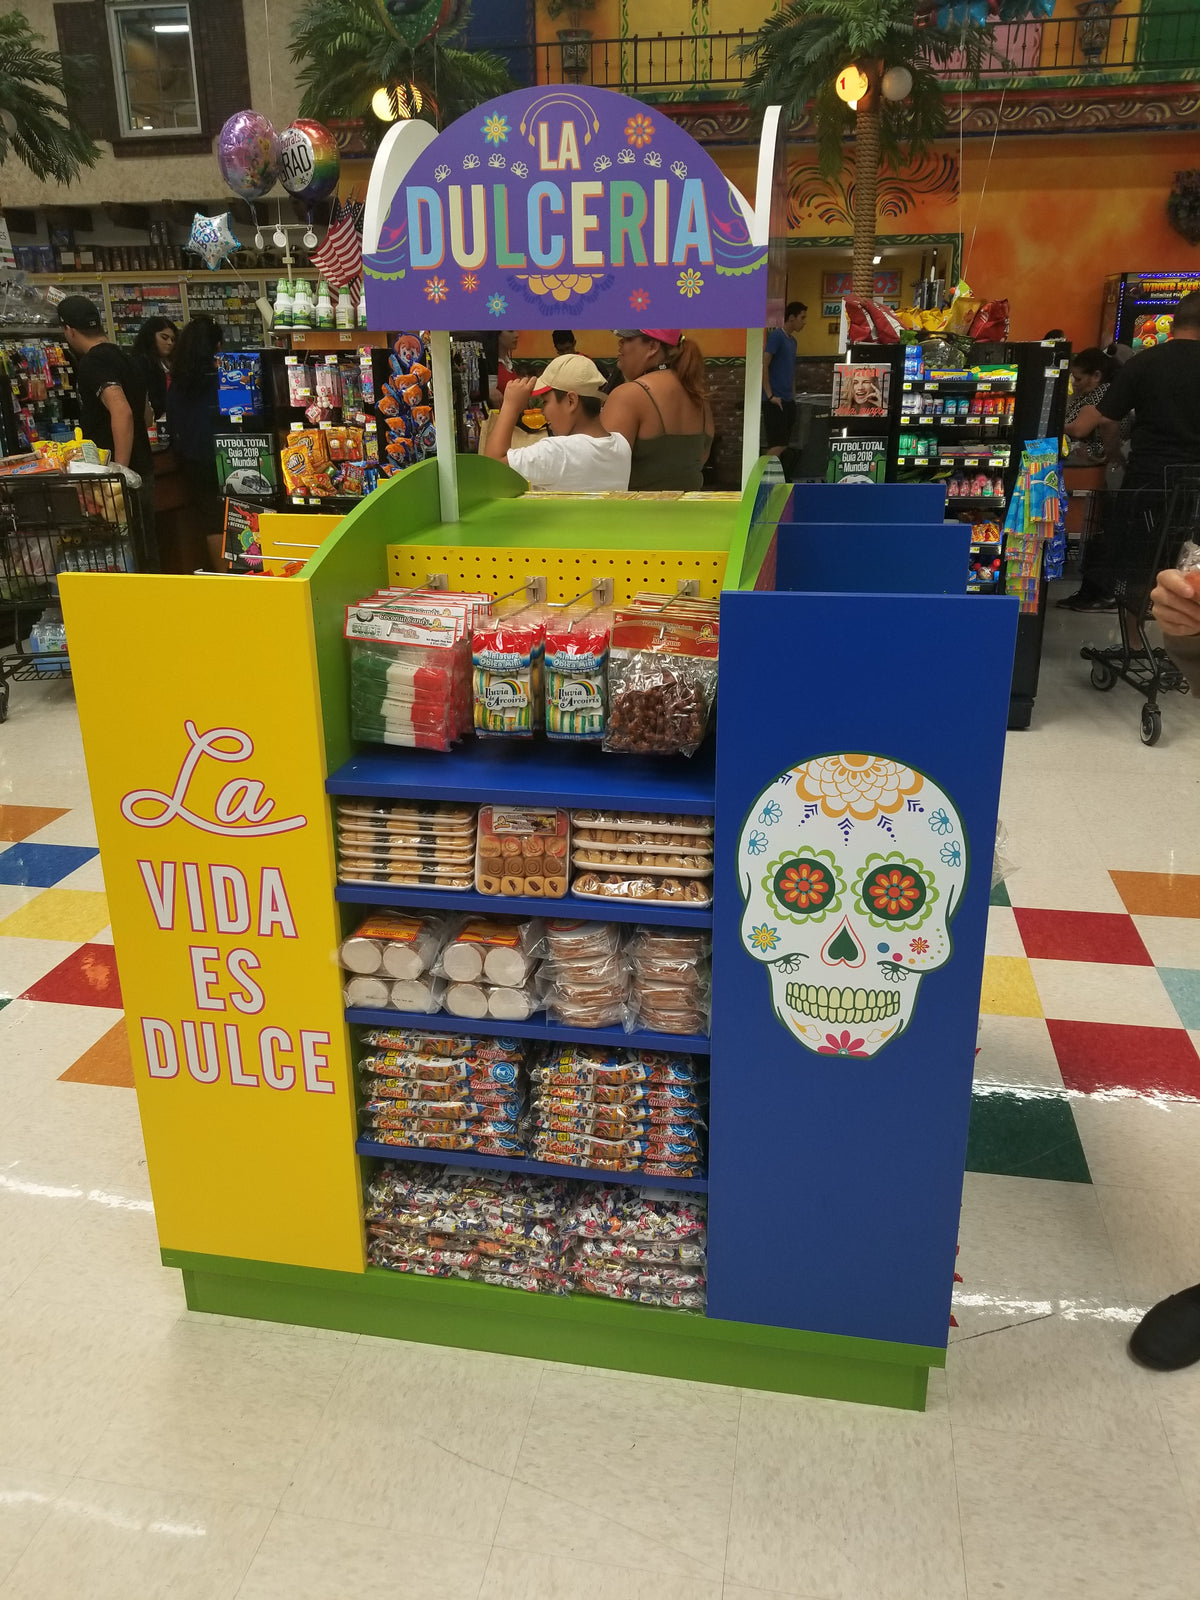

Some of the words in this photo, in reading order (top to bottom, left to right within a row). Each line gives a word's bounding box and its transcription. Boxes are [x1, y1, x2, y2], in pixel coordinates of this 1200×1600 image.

[840, 77, 845, 90] 1
[538, 121, 581, 171] LA
[406, 178, 714, 270] DULCERIA
[216, 438, 246, 448] FUTBOL
[245, 438, 269, 448] TOTAL
[832, 442, 861, 452] FUTBOL
[861, 441, 885, 451] TOTAL
[243, 448, 259, 457] 2018
[857, 452, 873, 462] 2018
[232, 458, 257, 467] Mundial
[843, 462, 870, 472] Mundial
[408, 615, 430, 627] Candy
[487, 696, 526, 708] Arcoiris
[560, 697, 600, 709] Arcoiris
[120, 719, 308, 838] La
[136, 859, 299, 938] VIDA
[189, 945, 266, 1015] ES
[140, 1016, 336, 1094] DULCE
